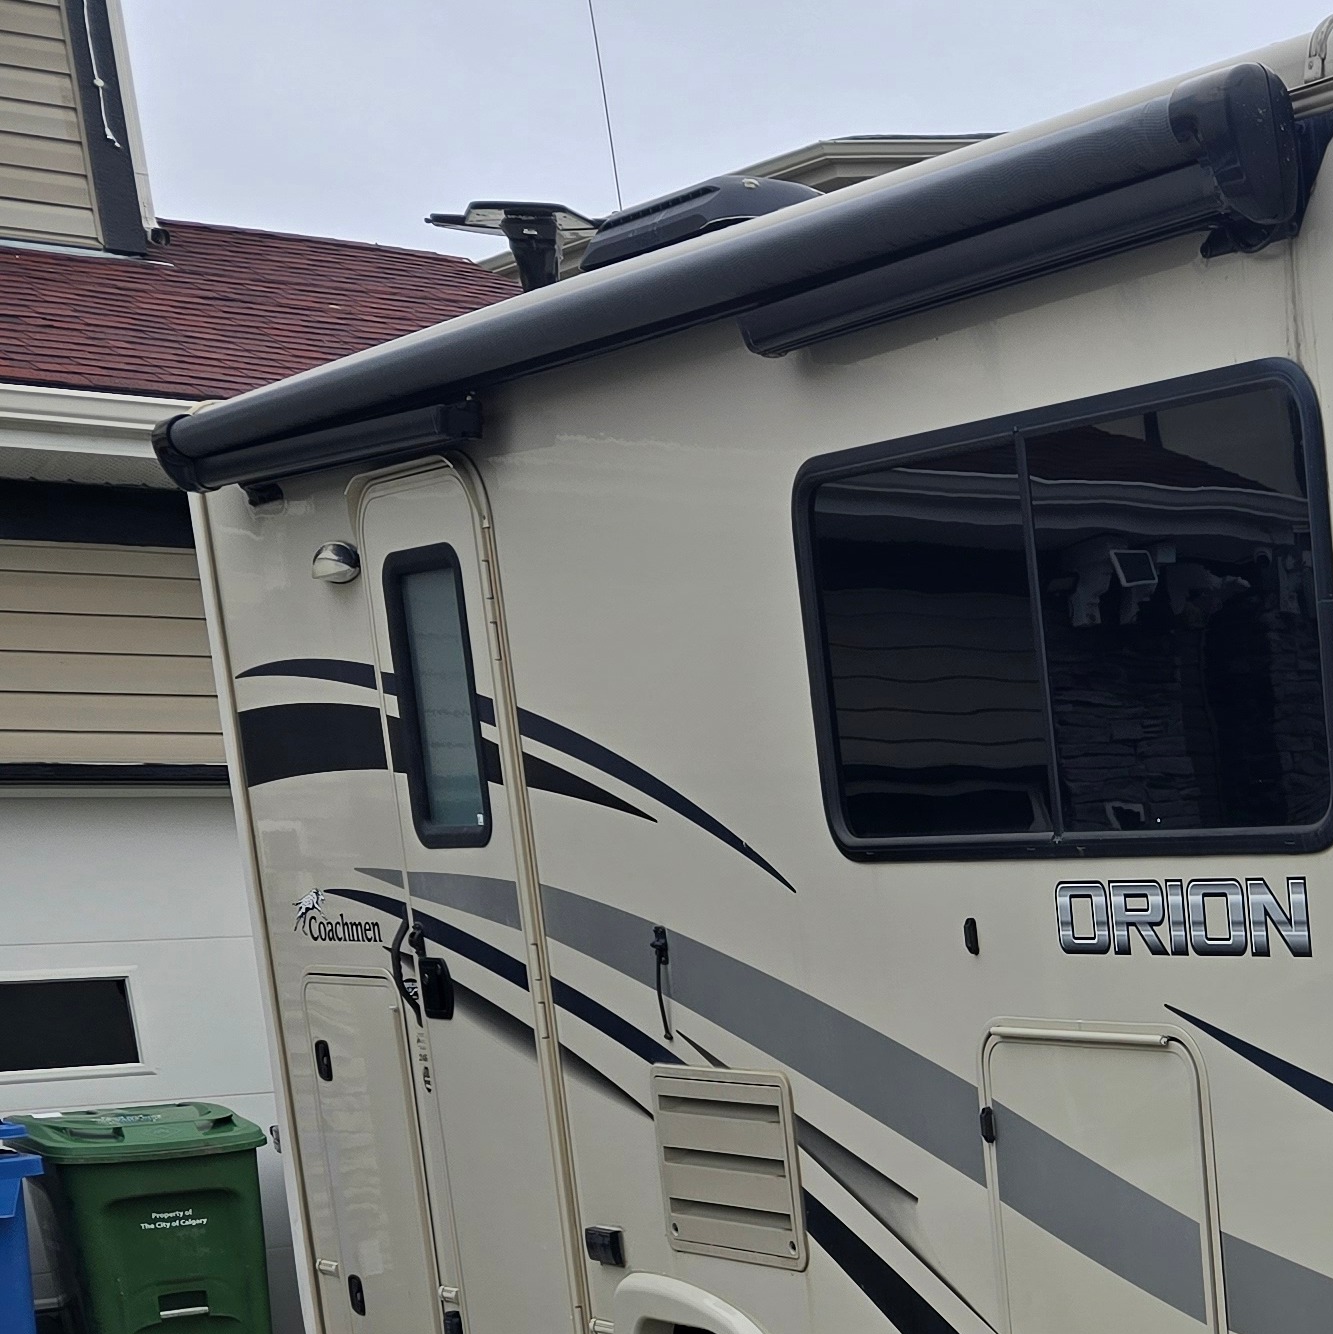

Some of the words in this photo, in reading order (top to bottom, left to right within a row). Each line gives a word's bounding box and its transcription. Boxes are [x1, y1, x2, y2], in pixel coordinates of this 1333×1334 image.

[1055, 876, 1313, 957] ORION
[308, 913, 383, 943] Coachmen
[140, 1222, 155, 1230] The
[155, 1221, 171, 1229] City
[171, 1219, 180, 1227] of
[180, 1218, 208, 1226] Calgary
[151, 1210, 183, 1219] Property
[184, 1208, 193, 1216] of
